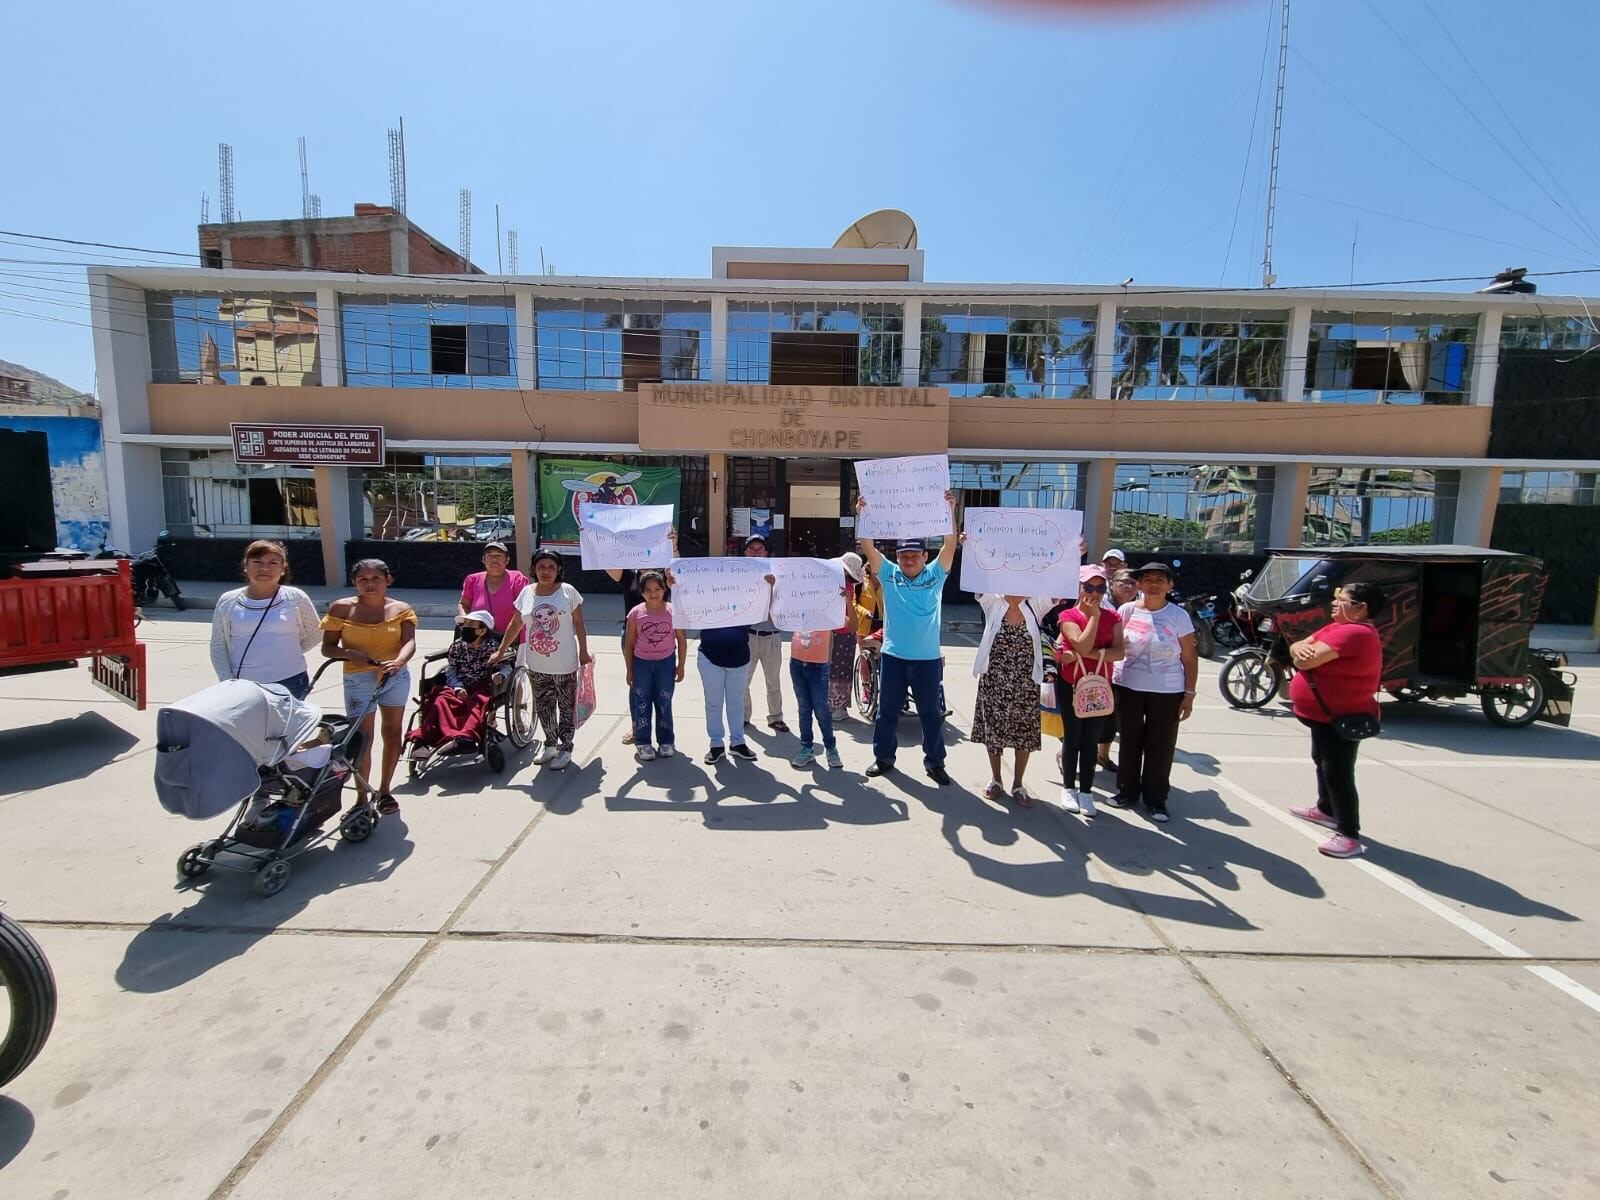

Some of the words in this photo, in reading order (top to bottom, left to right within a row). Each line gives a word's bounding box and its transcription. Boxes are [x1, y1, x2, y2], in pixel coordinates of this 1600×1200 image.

[652, 384, 815, 406] MUNICIPALIDAD
[828, 386, 937, 408] DISTRITAL
[779, 407, 806, 427] DE
[273, 431, 298, 440] PODER
[299, 431, 333, 440] JUDICIAL
[334, 432, 349, 440] DEL
[350, 431, 370, 441] PERÚ
[284, 439, 307, 447] SUPERIOR
[316, 440, 337, 448] JUSTICIA
[728, 428, 862, 449] CHONGOYAPE
[543, 463, 552, 475] 3
